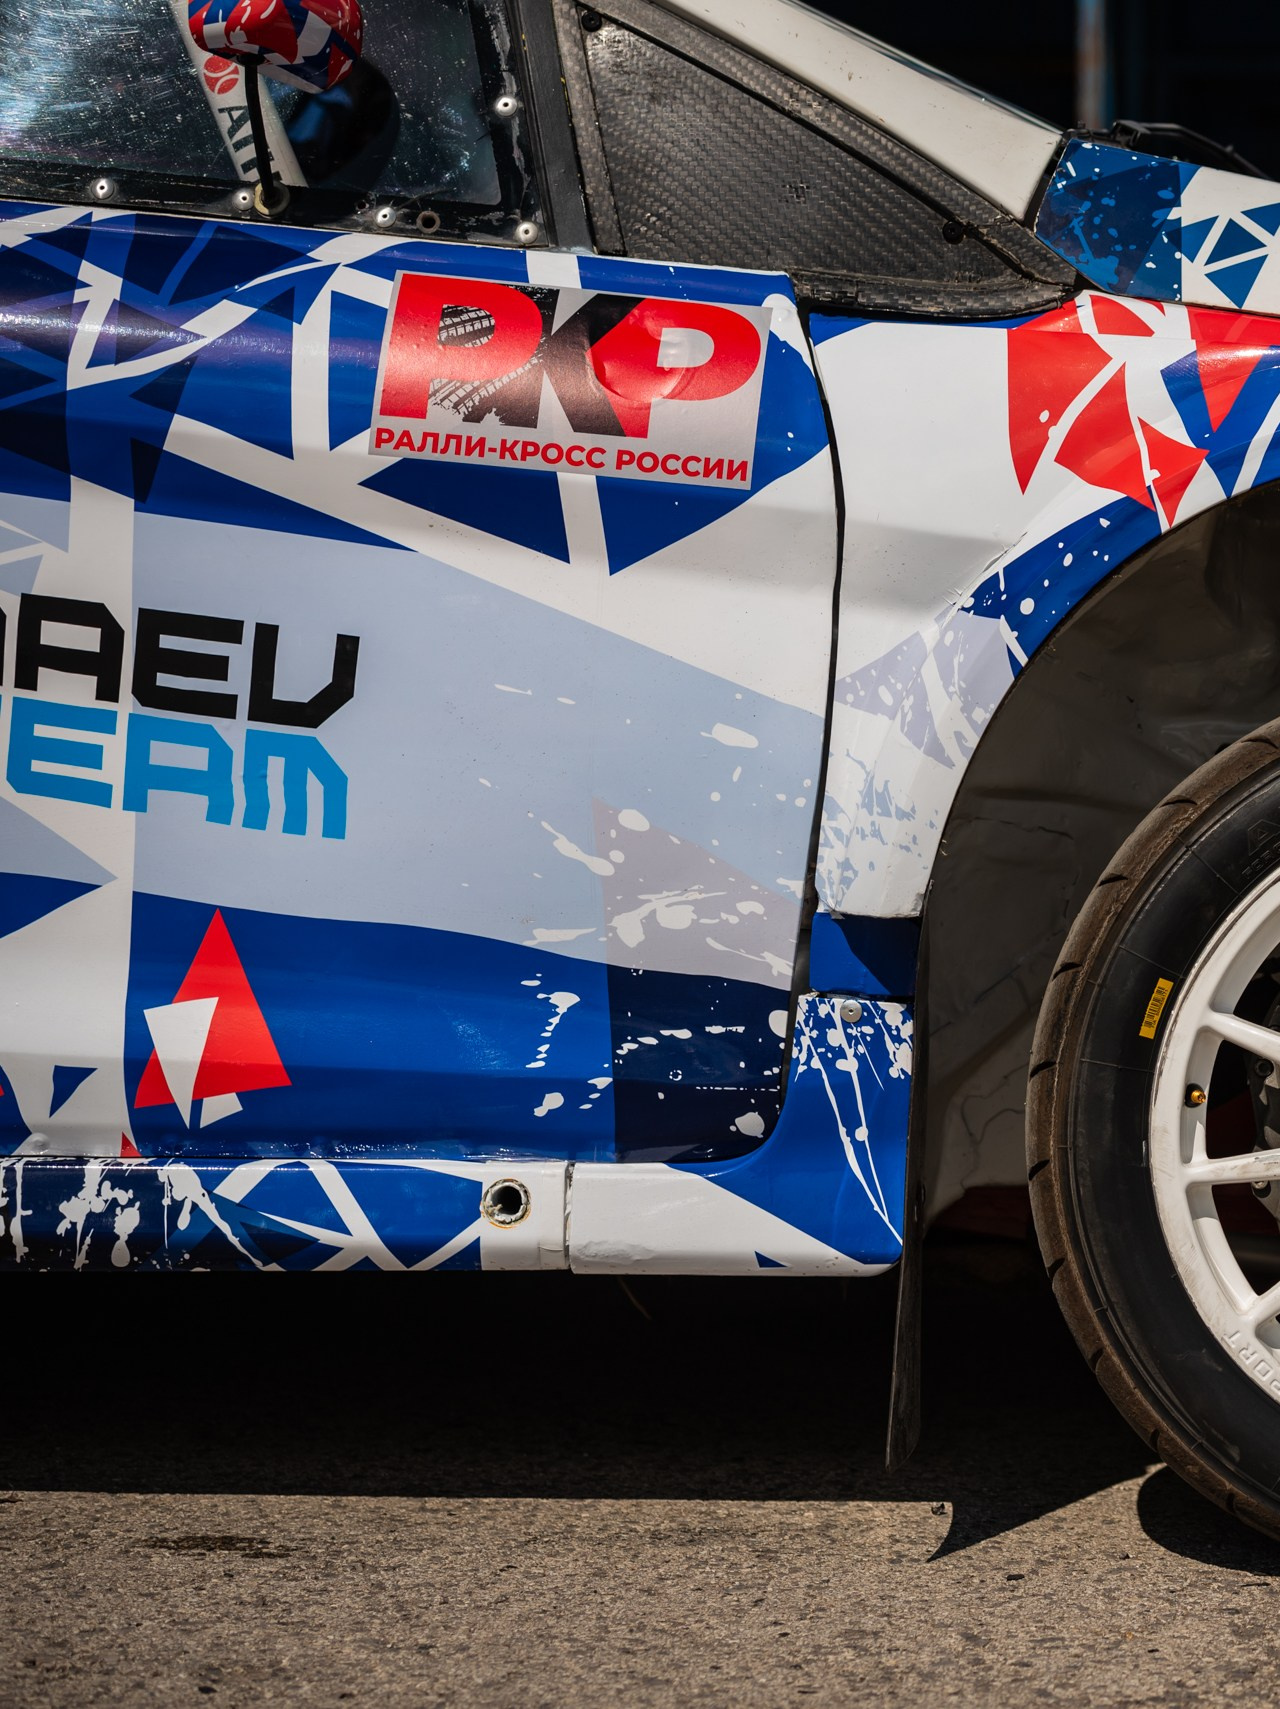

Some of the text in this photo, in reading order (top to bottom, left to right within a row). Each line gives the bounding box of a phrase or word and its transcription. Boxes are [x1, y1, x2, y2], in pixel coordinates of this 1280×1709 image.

[374, 427, 750, 482] РАЛЛИ-КРОСС РОССИИ
[0, 592, 361, 729] AEV
[0, 695, 349, 840] EAM
